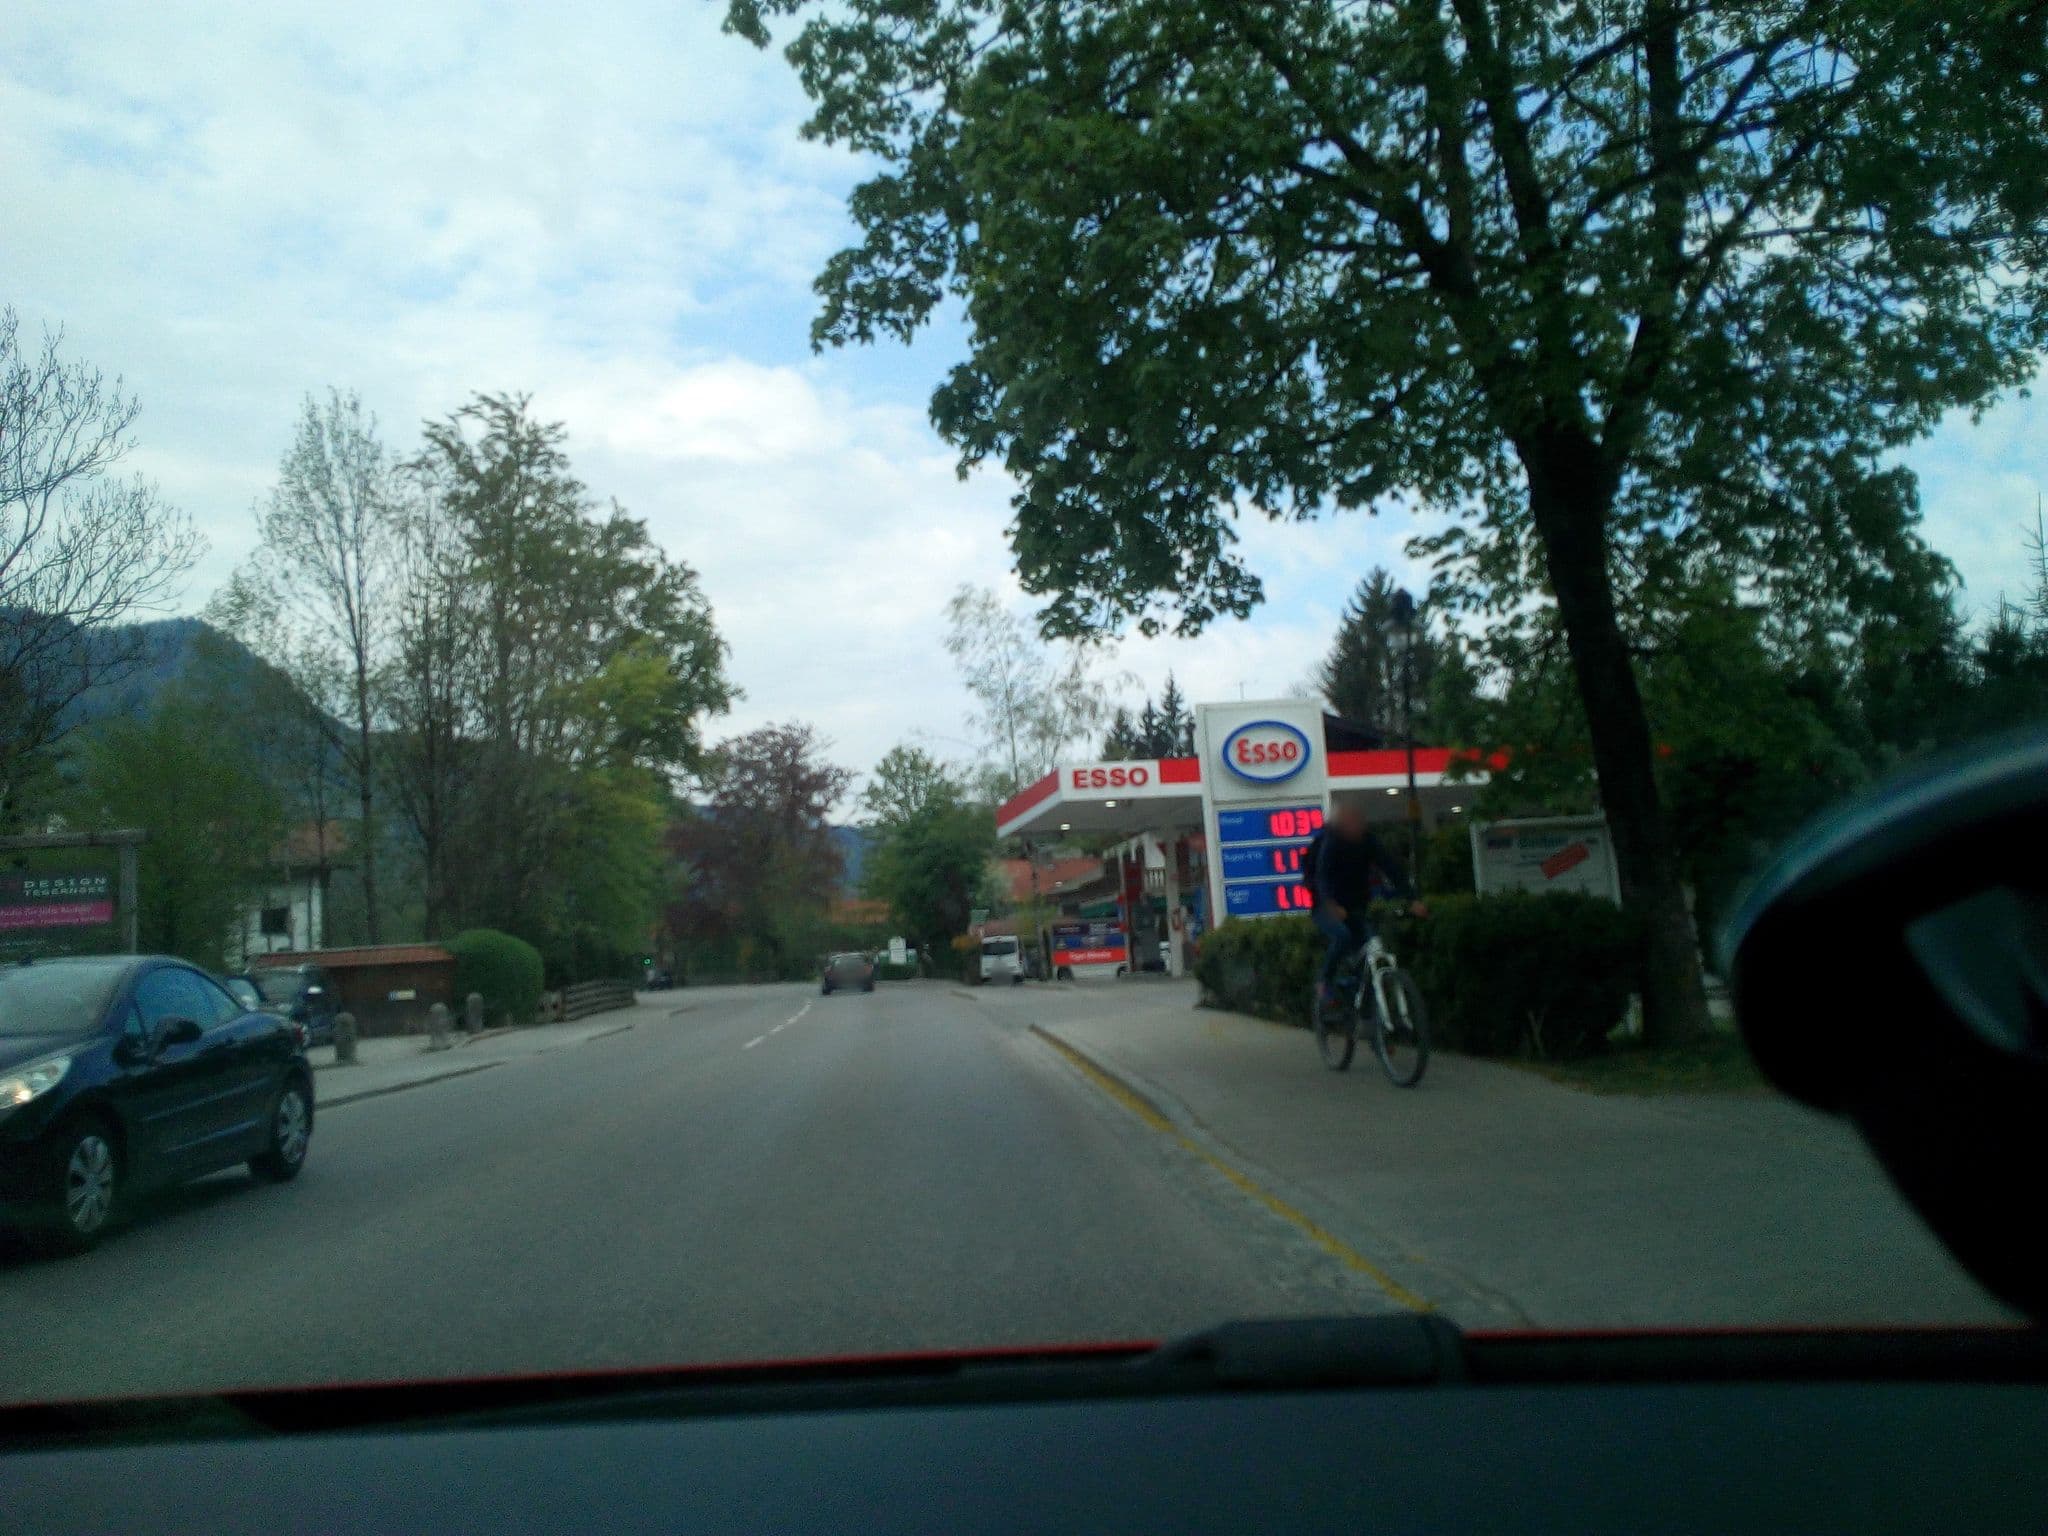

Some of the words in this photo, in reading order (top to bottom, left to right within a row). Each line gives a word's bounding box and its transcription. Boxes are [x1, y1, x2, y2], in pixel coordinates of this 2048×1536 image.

[1237, 738, 1298, 764] Esso
[1073, 767, 1149, 788] ESSO
[24, 877, 107, 888] DESIGN
